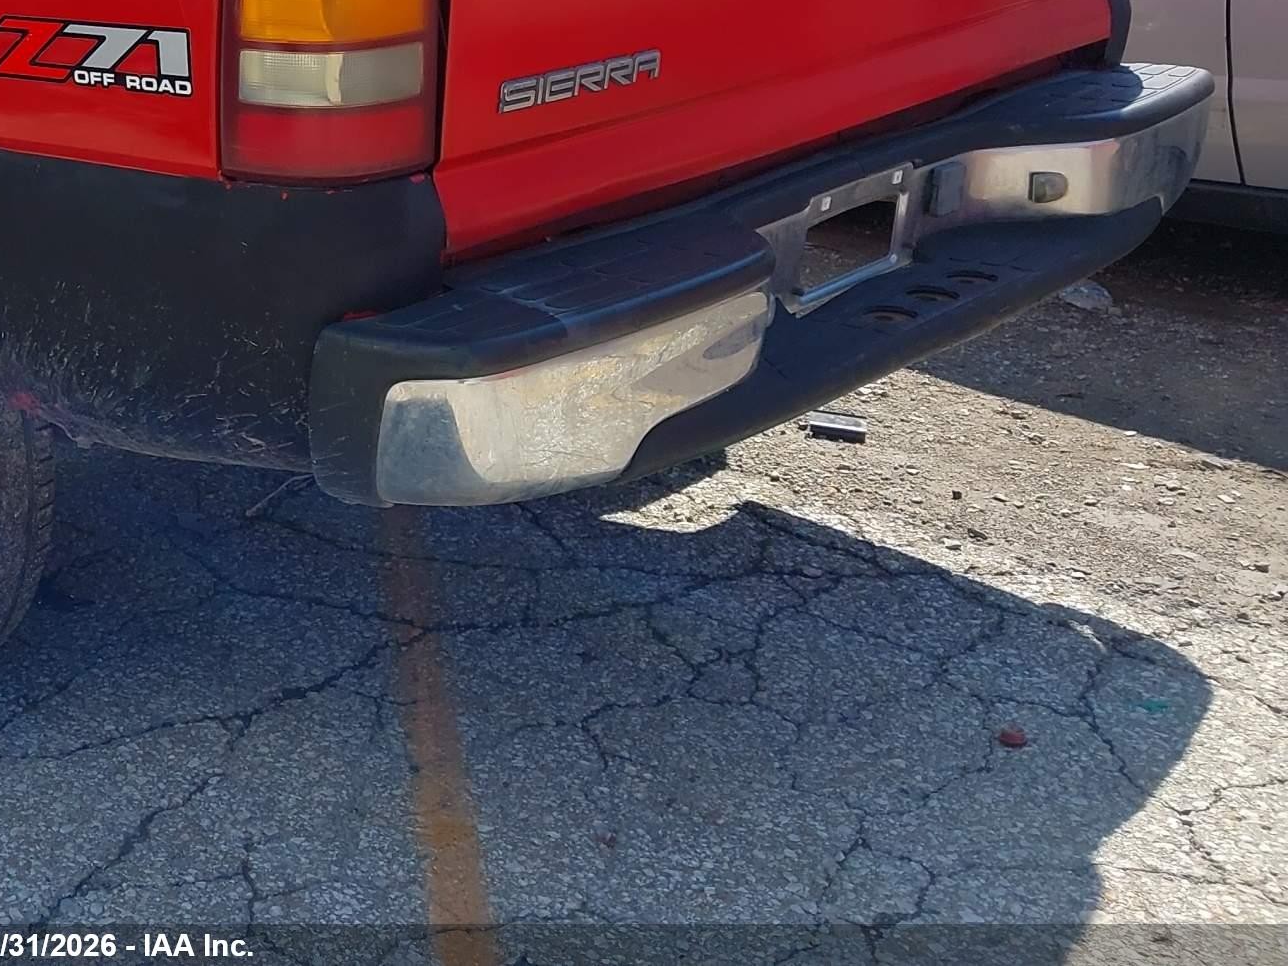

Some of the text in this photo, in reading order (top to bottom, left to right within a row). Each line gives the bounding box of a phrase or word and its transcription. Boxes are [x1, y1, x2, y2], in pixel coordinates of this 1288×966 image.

[73, 68, 193, 96] OFF ROAD
[498, 49, 661, 114] SIERRA
